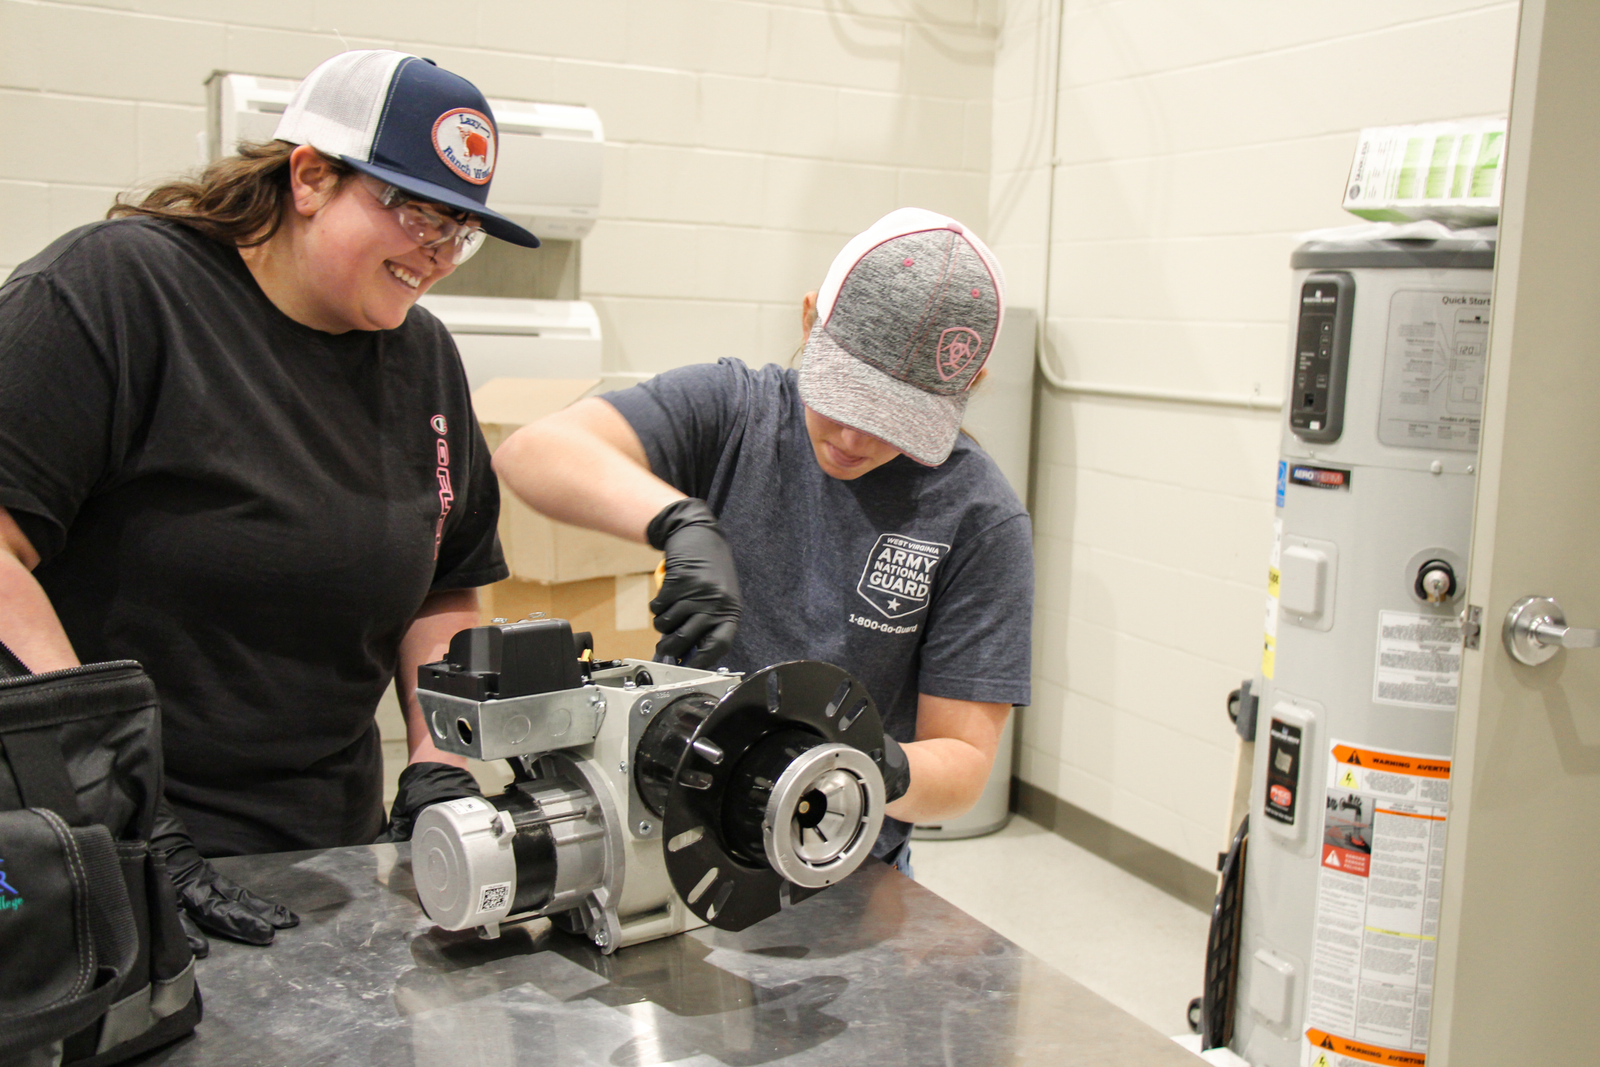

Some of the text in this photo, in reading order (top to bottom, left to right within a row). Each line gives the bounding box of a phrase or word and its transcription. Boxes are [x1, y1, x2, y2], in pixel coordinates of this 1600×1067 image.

[459, 114, 481, 129] Lazy
[443, 145, 471, 176] Ranch
[1442, 296, 1491, 305] Quick Start
[887, 537, 940, 555] WEST VIRGINIA
[877, 547, 938, 573] ARMY
[873, 560, 931, 584] NATIONAL
[869, 571, 929, 598] GUARD
[848, 613, 918, 634] 1-800-Go-Guard
[1372, 757, 1411, 769] WARNING
[1344, 1045, 1382, 1058] WARNING
